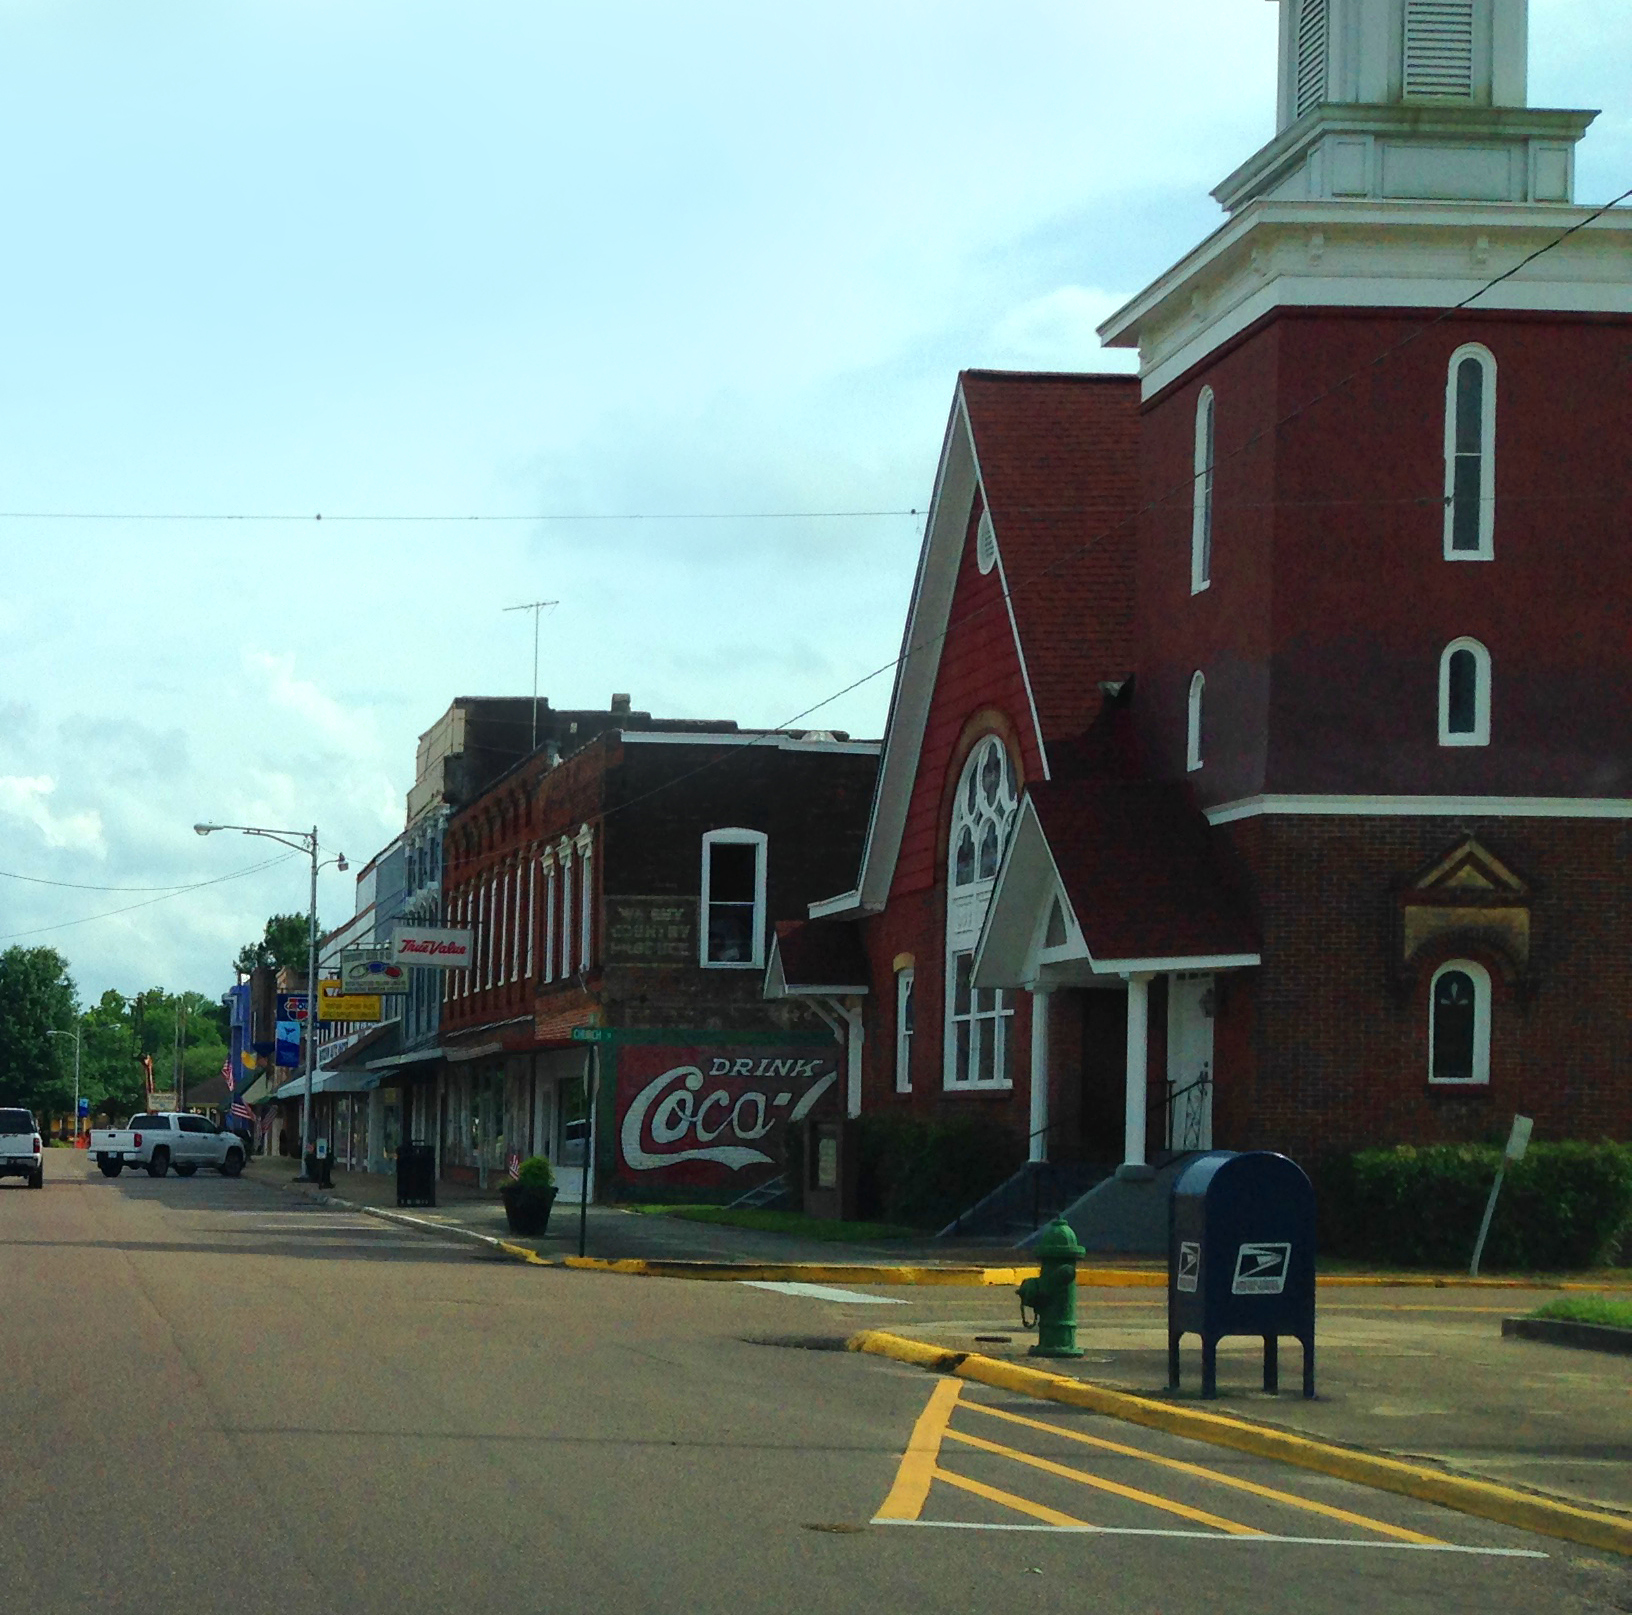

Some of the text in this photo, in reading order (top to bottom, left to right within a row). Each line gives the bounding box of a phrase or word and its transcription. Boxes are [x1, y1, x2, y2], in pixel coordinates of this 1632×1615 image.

[398, 939, 467, 956] True Value
[709, 1058, 823, 1077] DRINK
